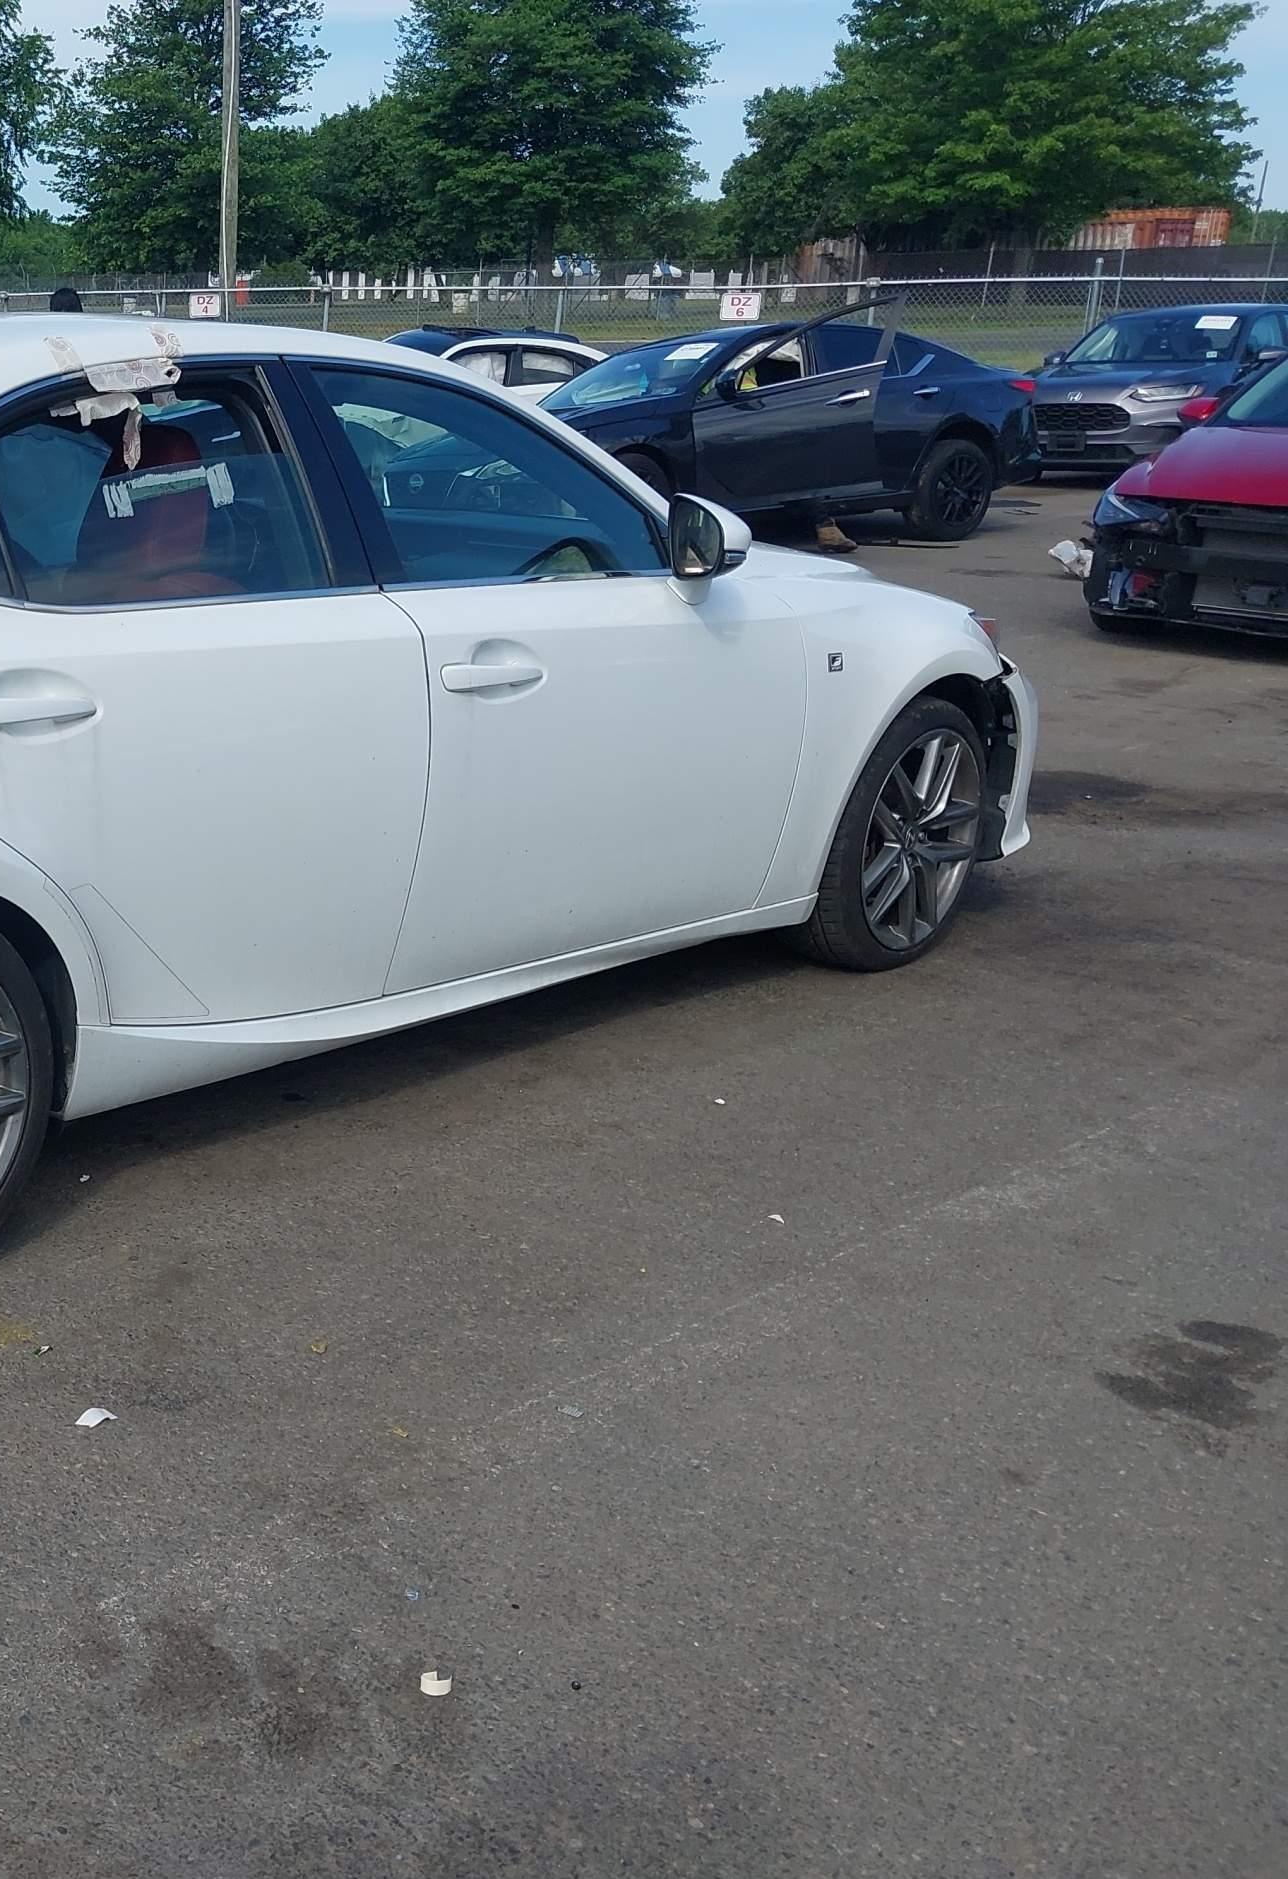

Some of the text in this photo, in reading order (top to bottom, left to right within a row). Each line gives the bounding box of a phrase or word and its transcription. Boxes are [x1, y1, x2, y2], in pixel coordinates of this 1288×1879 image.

[197, 296, 214, 305] DZ
[731, 297, 753, 306] DZ
[202, 306, 209, 314] 4
[736, 308, 745, 317] 6
